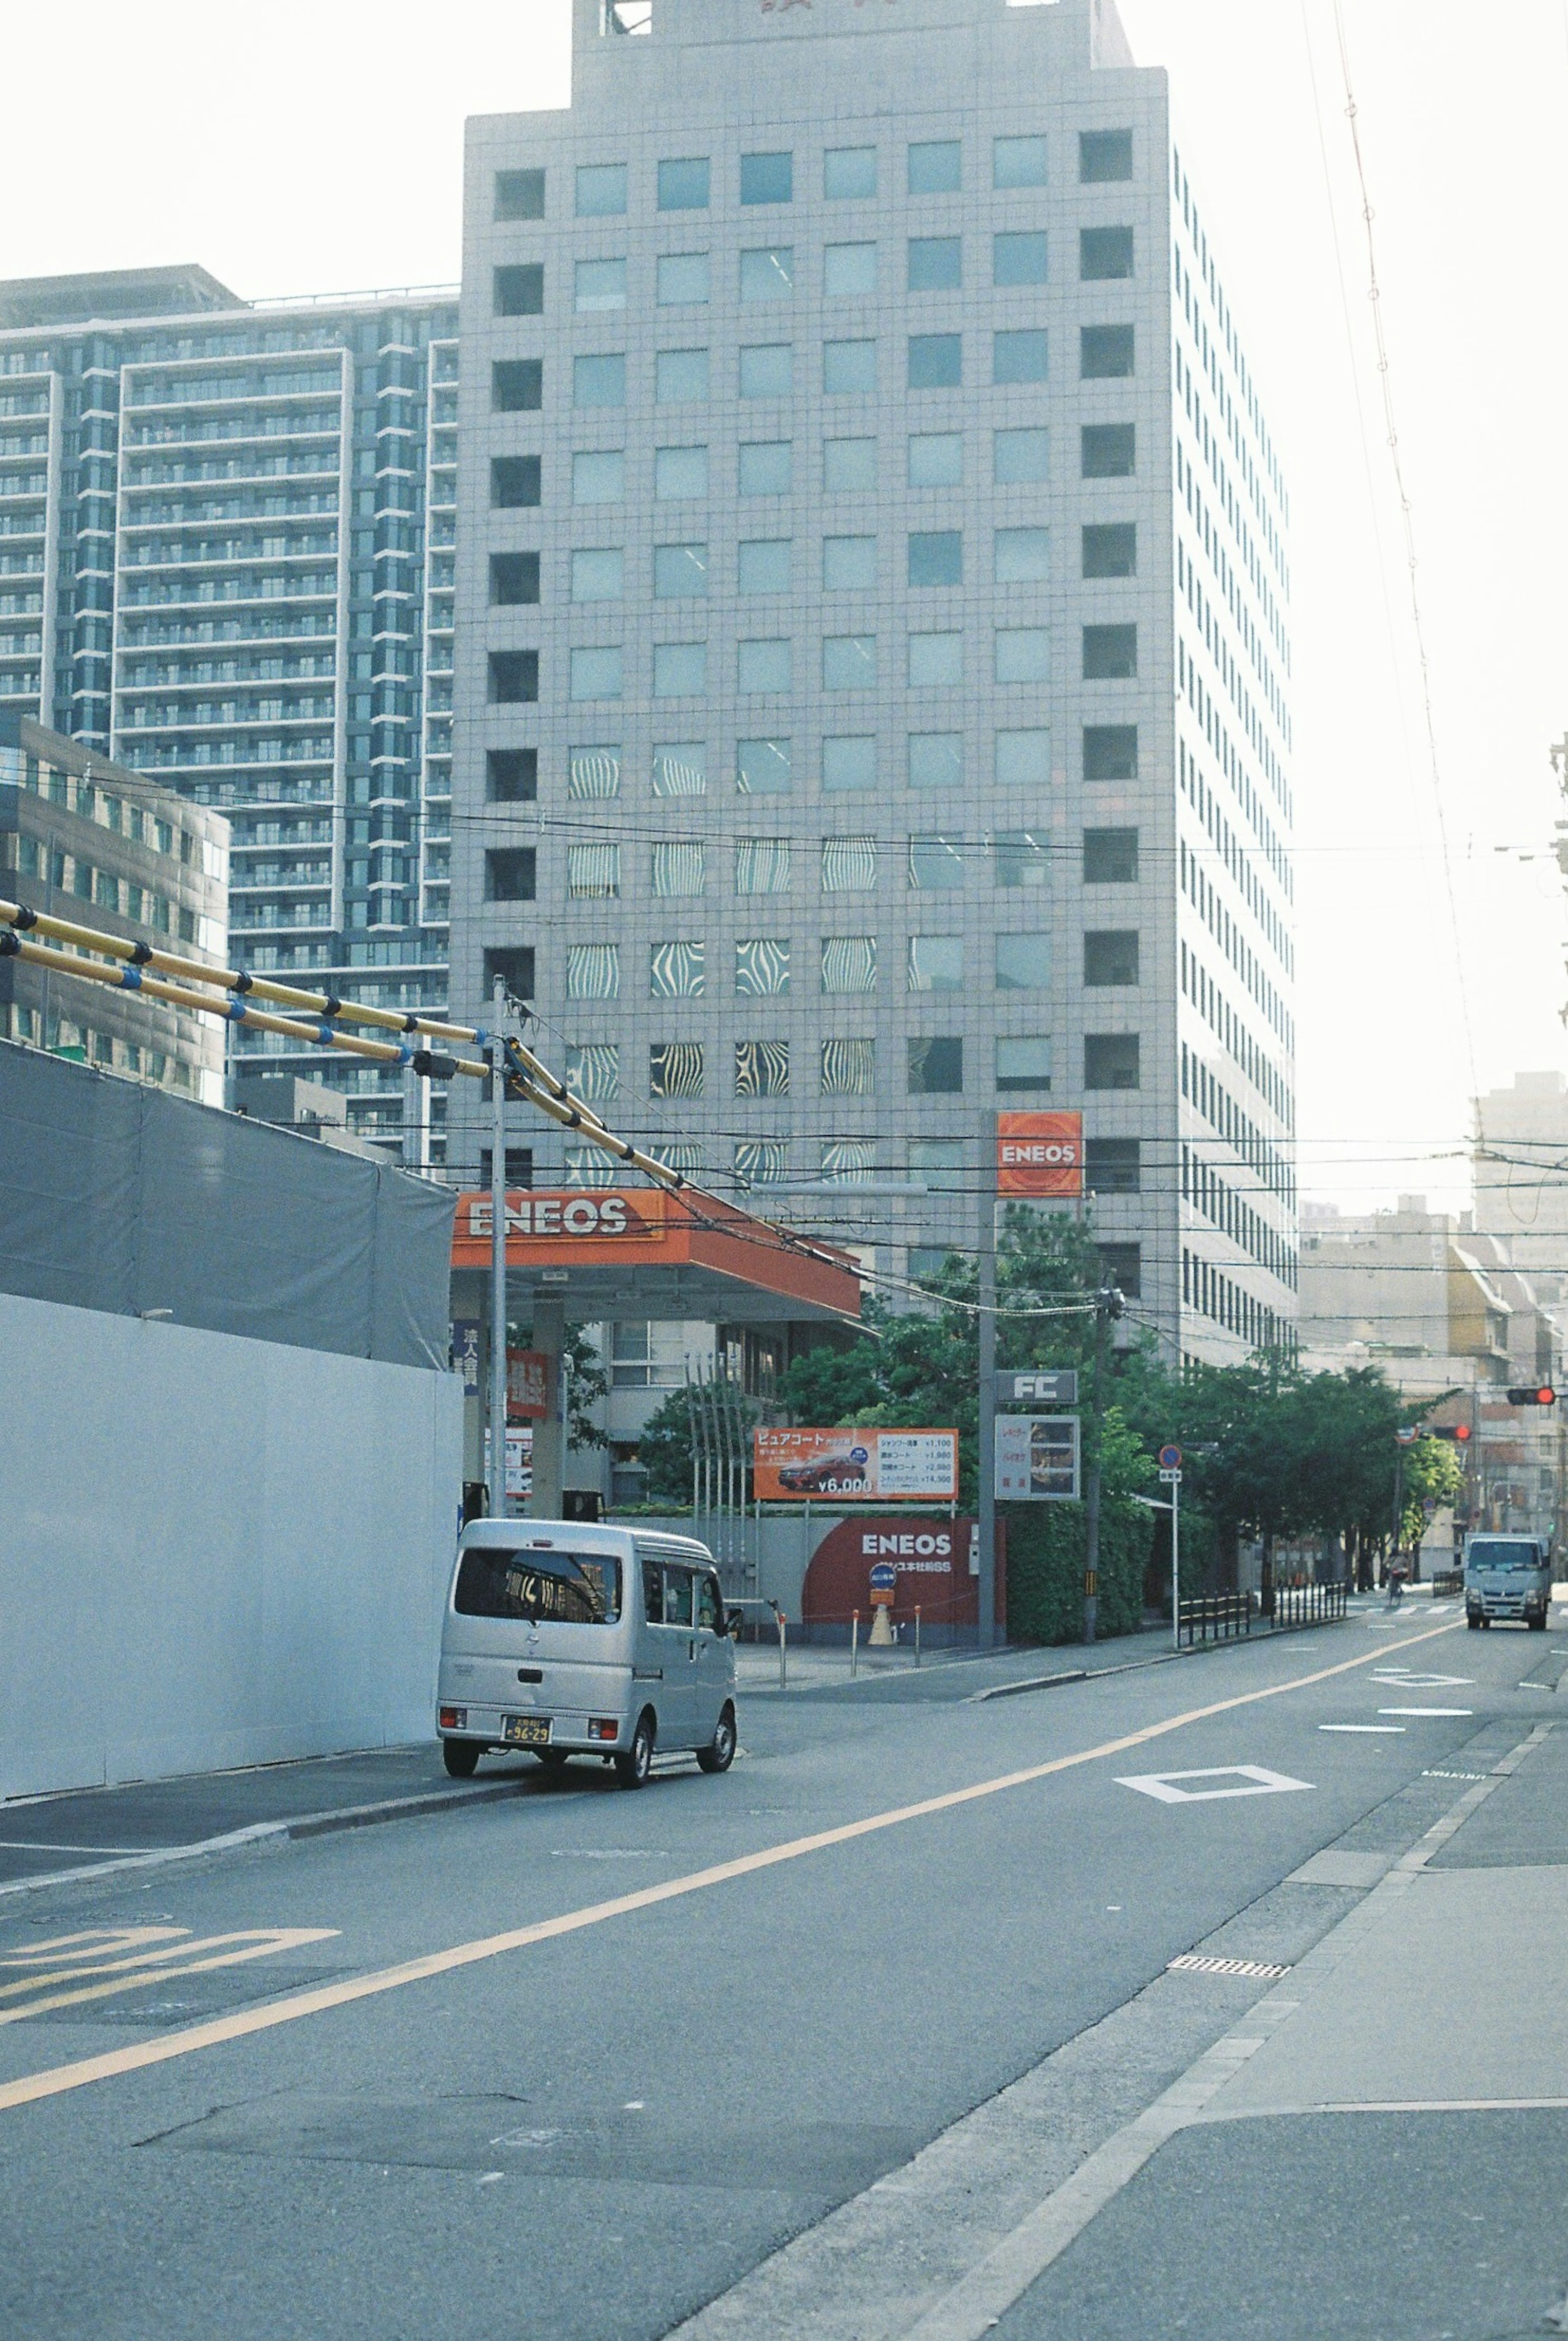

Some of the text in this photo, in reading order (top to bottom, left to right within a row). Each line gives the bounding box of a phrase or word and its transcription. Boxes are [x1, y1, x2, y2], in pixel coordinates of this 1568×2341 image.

[1002, 1145, 1076, 1163] ENEOS
[469, 1198, 628, 1236] ENEOS
[1014, 1376, 1059, 1399] FC
[758, 1433, 824, 1446] ピュアコート
[862, 1534, 951, 1555] ENEOS
[513, 1726, 548, 1742] 96-29
